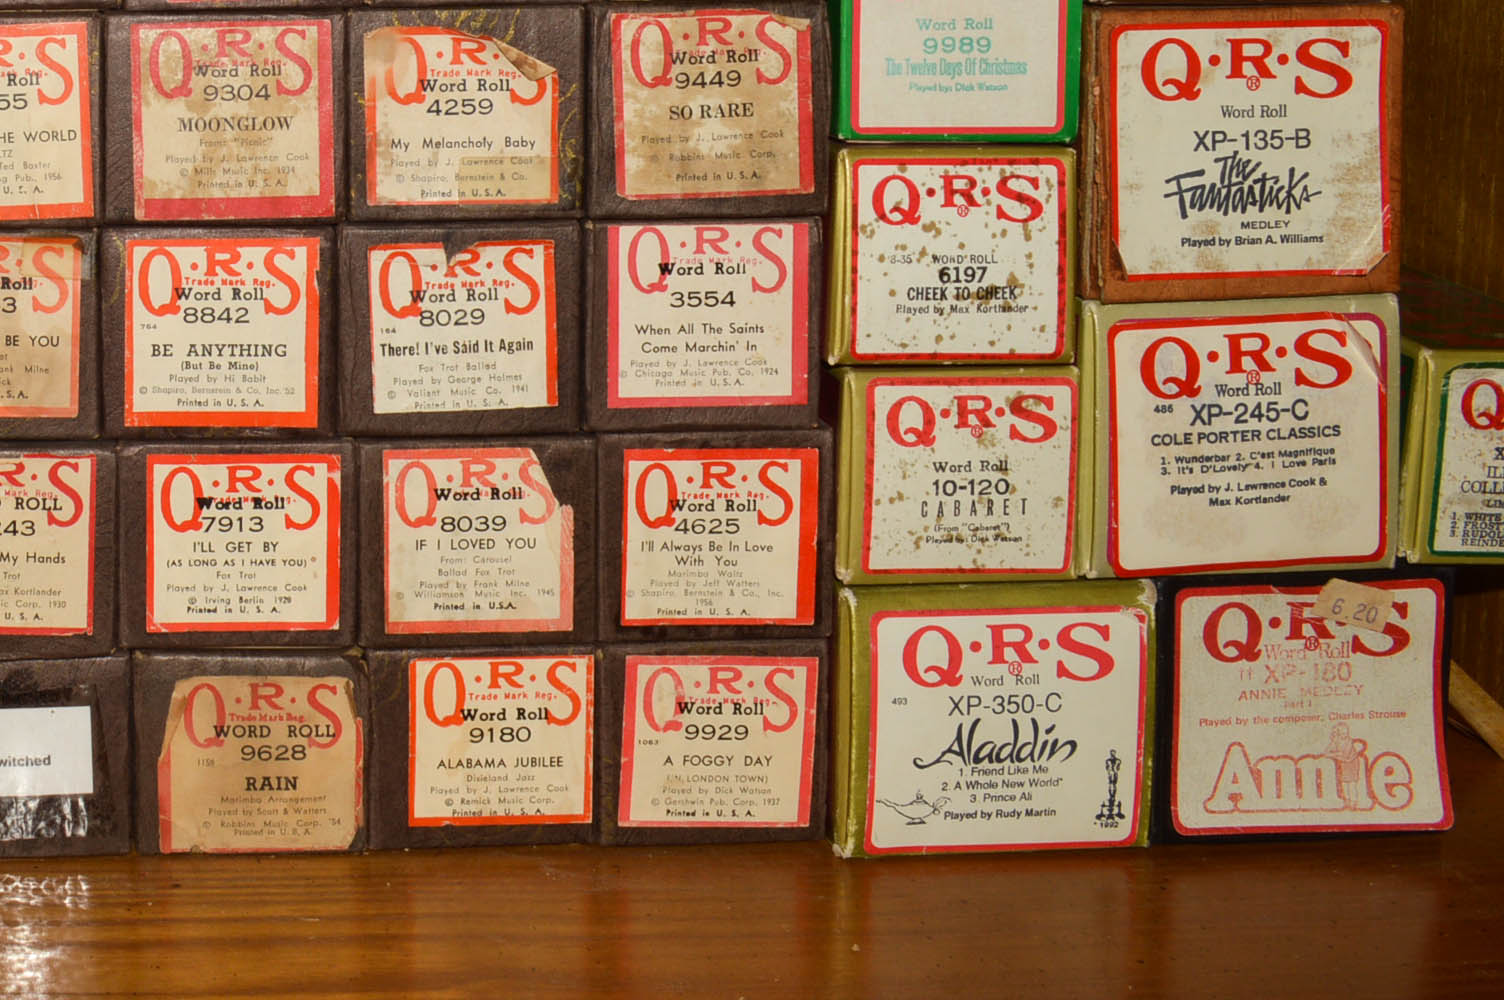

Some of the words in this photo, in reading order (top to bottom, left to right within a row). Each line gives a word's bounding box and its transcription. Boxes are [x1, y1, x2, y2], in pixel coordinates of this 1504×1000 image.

[924, 36, 992, 54] 9989
[676, 70, 741, 89] 9449
[179, 116, 293, 132] MOONGLOW
[1194, 128, 1311, 152] XP-135-B
[1214, 151, 1268, 189] The
[1241, 220, 1290, 229] MEDLEY
[1181, 237, 1216, 248] Played
[1219, 237, 1232, 247] by
[1235, 236, 1262, 245] Brian
[1265, 235, 1277, 244] A.
[1280, 234, 1324, 243] Williams
[939, 266, 987, 284] 6197
[670, 291, 736, 308] 3554
[184, 307, 249, 323] 8842
[420, 308, 485, 327] 8029
[1190, 399, 1309, 426] XP-245-C
[933, 478, 1010, 496] 10-120
[921, 498, 1027, 520] CABARET
[202, 516, 264, 532] 7913
[674, 519, 740, 534] 4625
[949, 692, 1062, 716] XP-350-C
[470, 727, 531, 743] 9180
[685, 724, 748, 740] 9929
[241, 745, 306, 761] 9628
[913, 718, 1077, 773] Aladdin
[245, 776, 297, 791] RAIN
